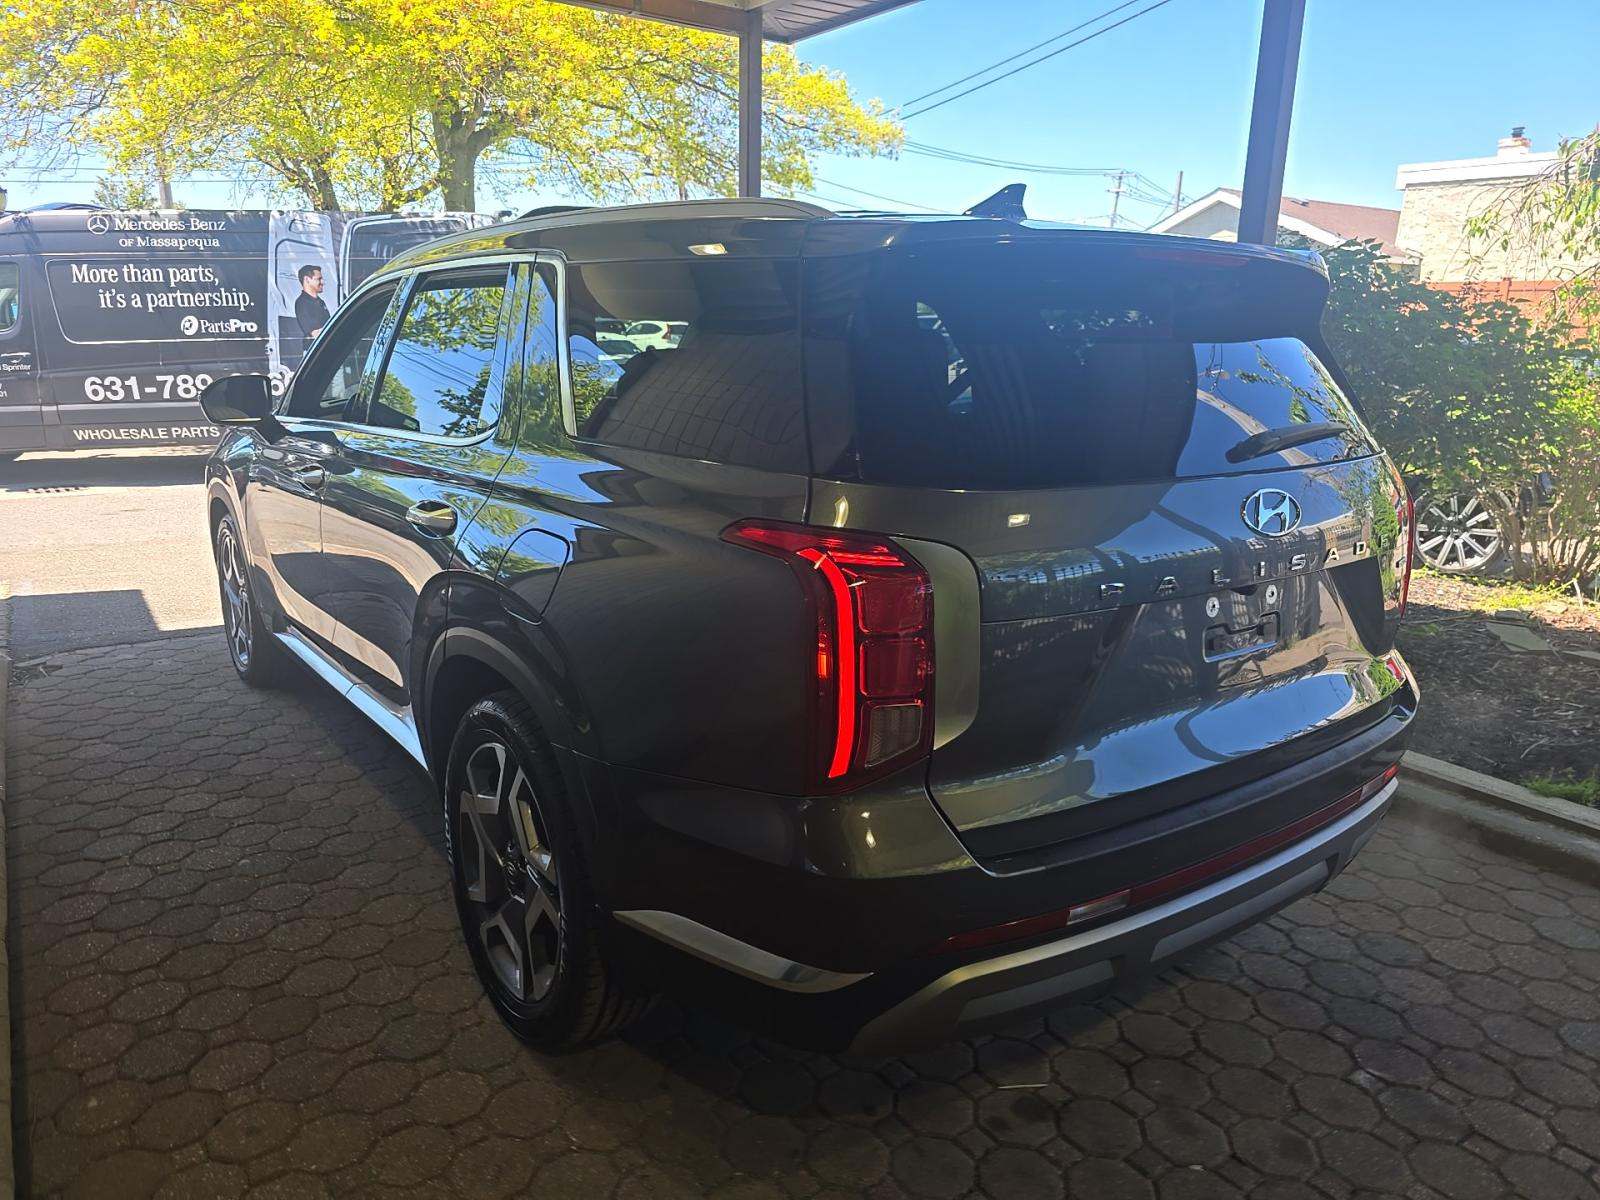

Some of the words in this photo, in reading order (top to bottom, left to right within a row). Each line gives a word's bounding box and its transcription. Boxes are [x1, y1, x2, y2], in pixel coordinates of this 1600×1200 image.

[115, 217, 226, 231] Mercedes-Benz
[136, 236, 220, 250] Massapequa
[71, 264, 119, 283] More
[123, 263, 165, 283] than
[167, 265, 219, 287] parts,
[99, 288, 127, 308] it's
[131, 293, 142, 308] a
[146, 288, 255, 312] partnership.
[201, 319, 258, 333] PartsPro
[73, 428, 169, 441] WHOLESALE
[171, 427, 220, 438] PARTS
